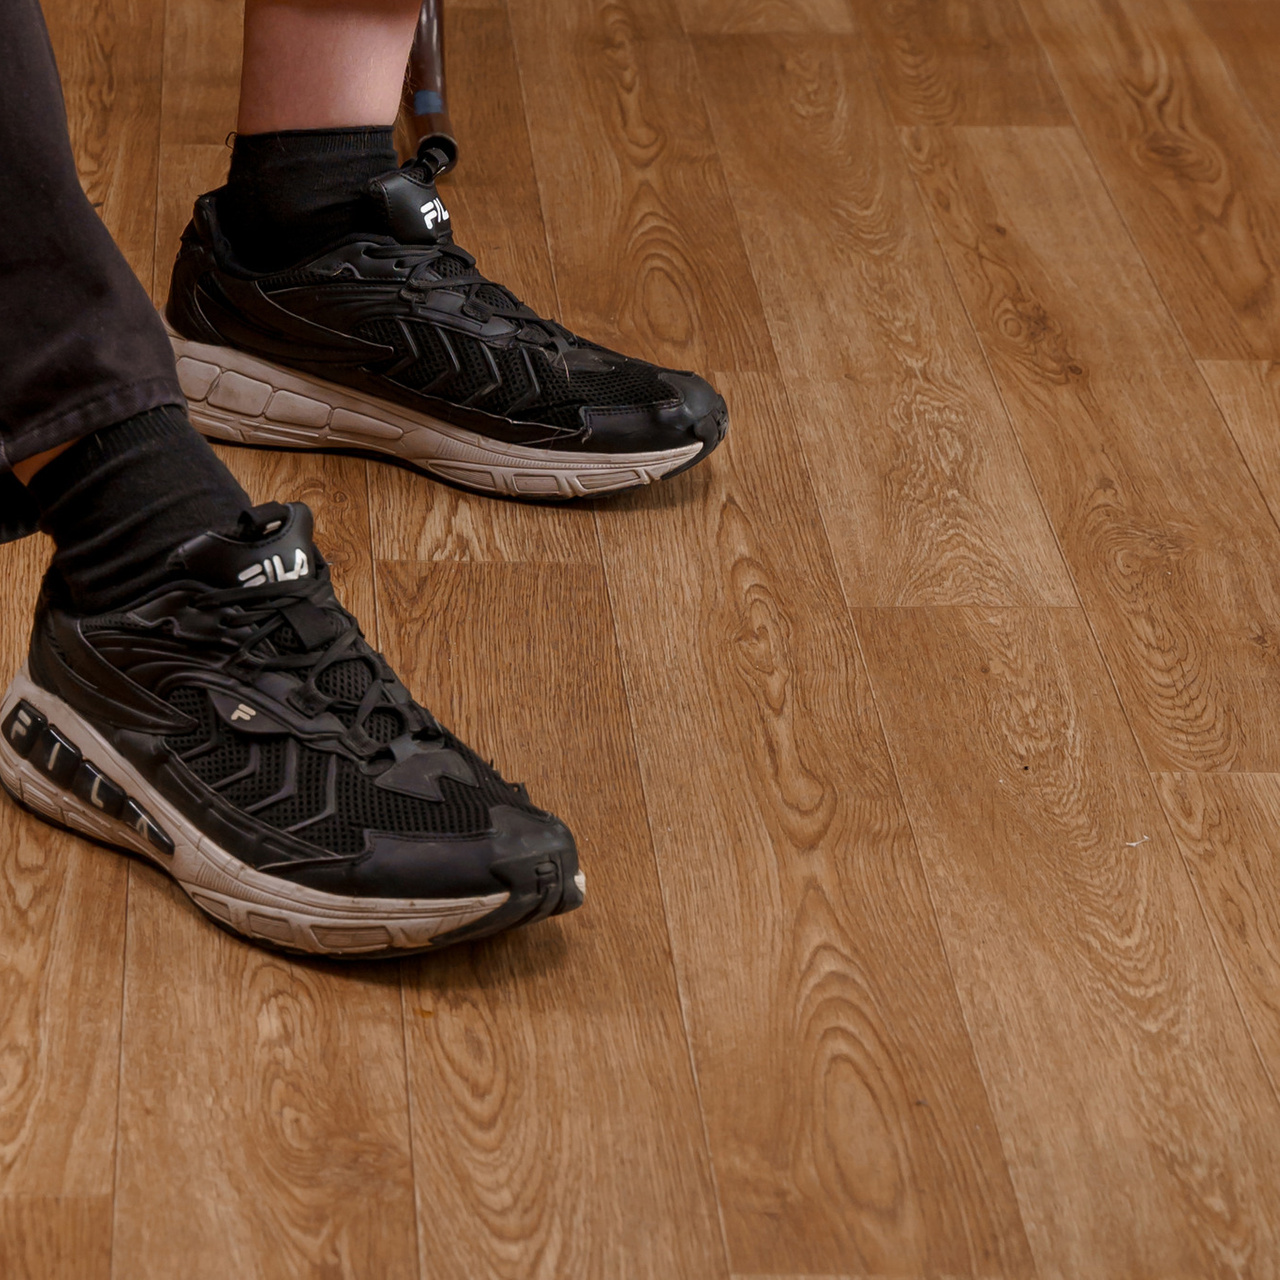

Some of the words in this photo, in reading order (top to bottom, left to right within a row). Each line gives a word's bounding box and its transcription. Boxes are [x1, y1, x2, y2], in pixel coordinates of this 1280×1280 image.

[420, 197, 450, 230] FIL
[238, 548, 309, 588] FILA
[10, 709, 150, 840] FILA
